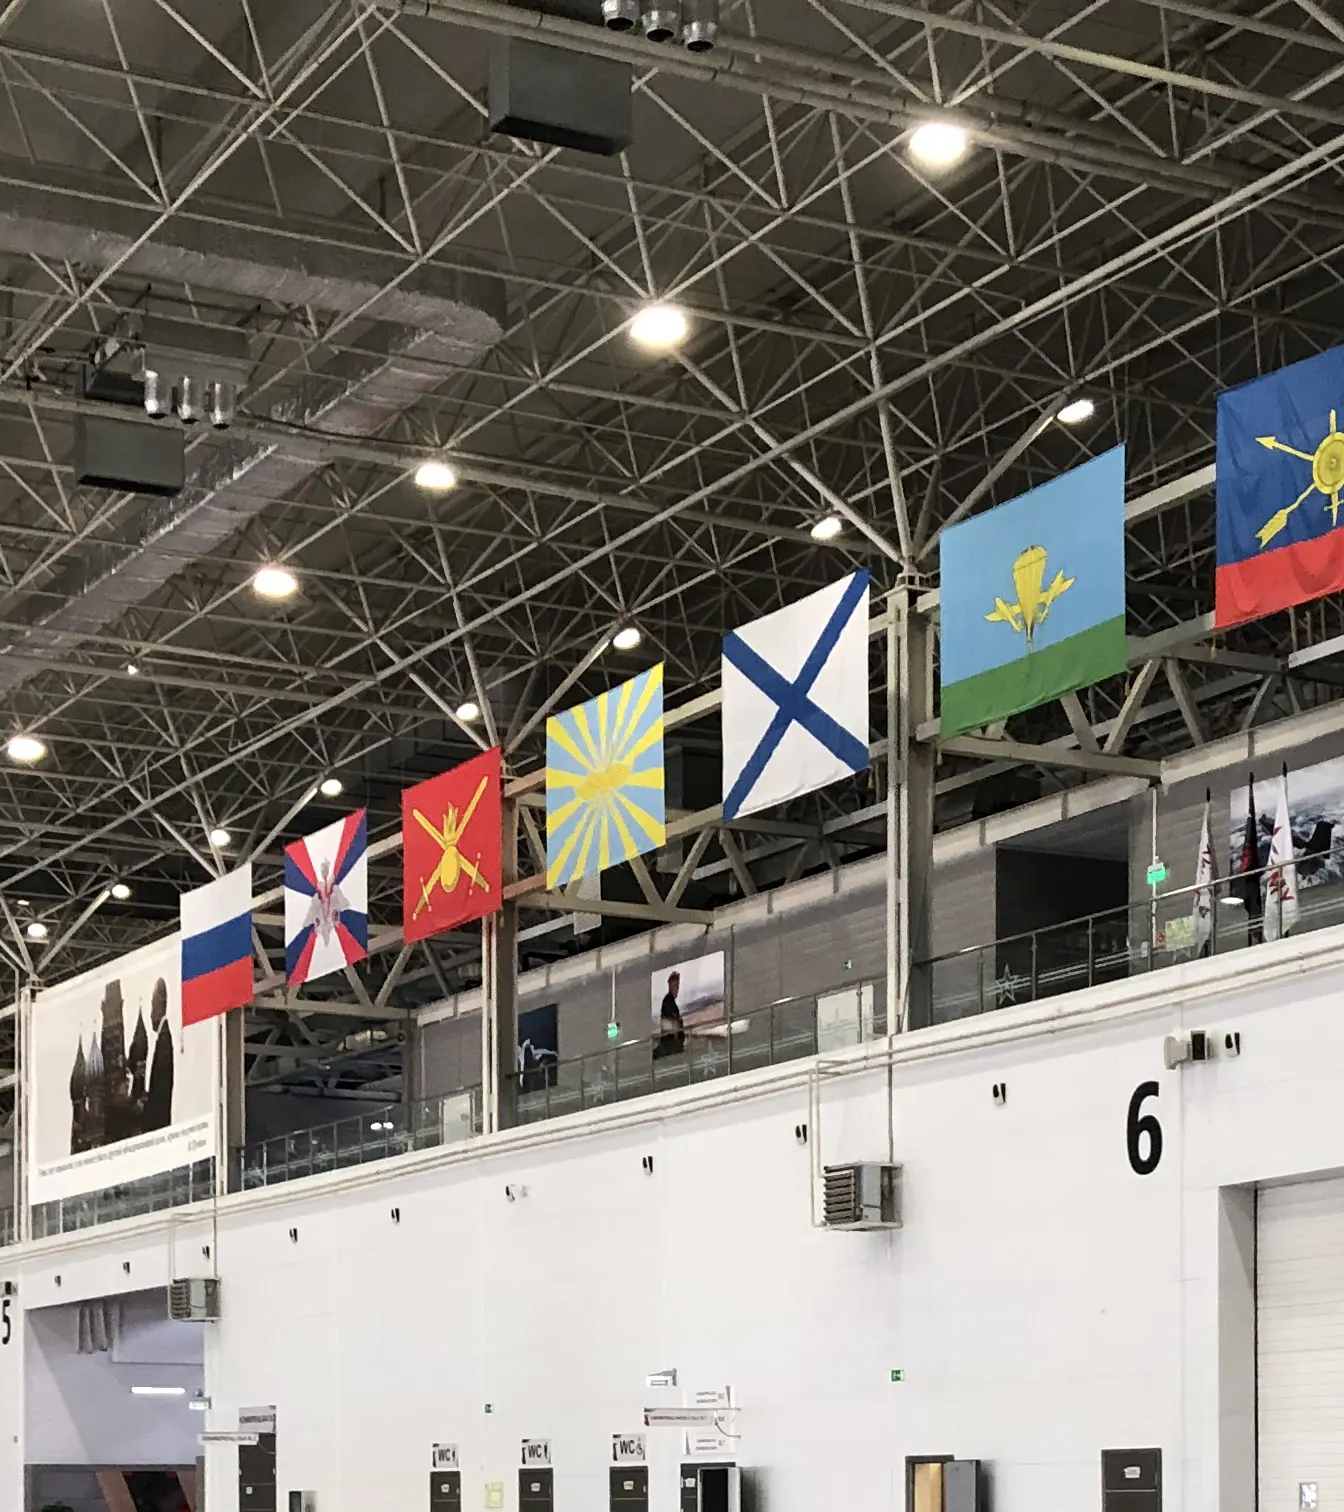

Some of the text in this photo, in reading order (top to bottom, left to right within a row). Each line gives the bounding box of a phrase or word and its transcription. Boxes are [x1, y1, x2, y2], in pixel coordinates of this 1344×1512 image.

[1126, 1080, 1163, 1175] 6
[1, 1299, 11, 1345] 5
[438, 1448, 451, 1461] WC
[527, 1444, 542, 1459] WC
[619, 1439, 636, 1455] WC
